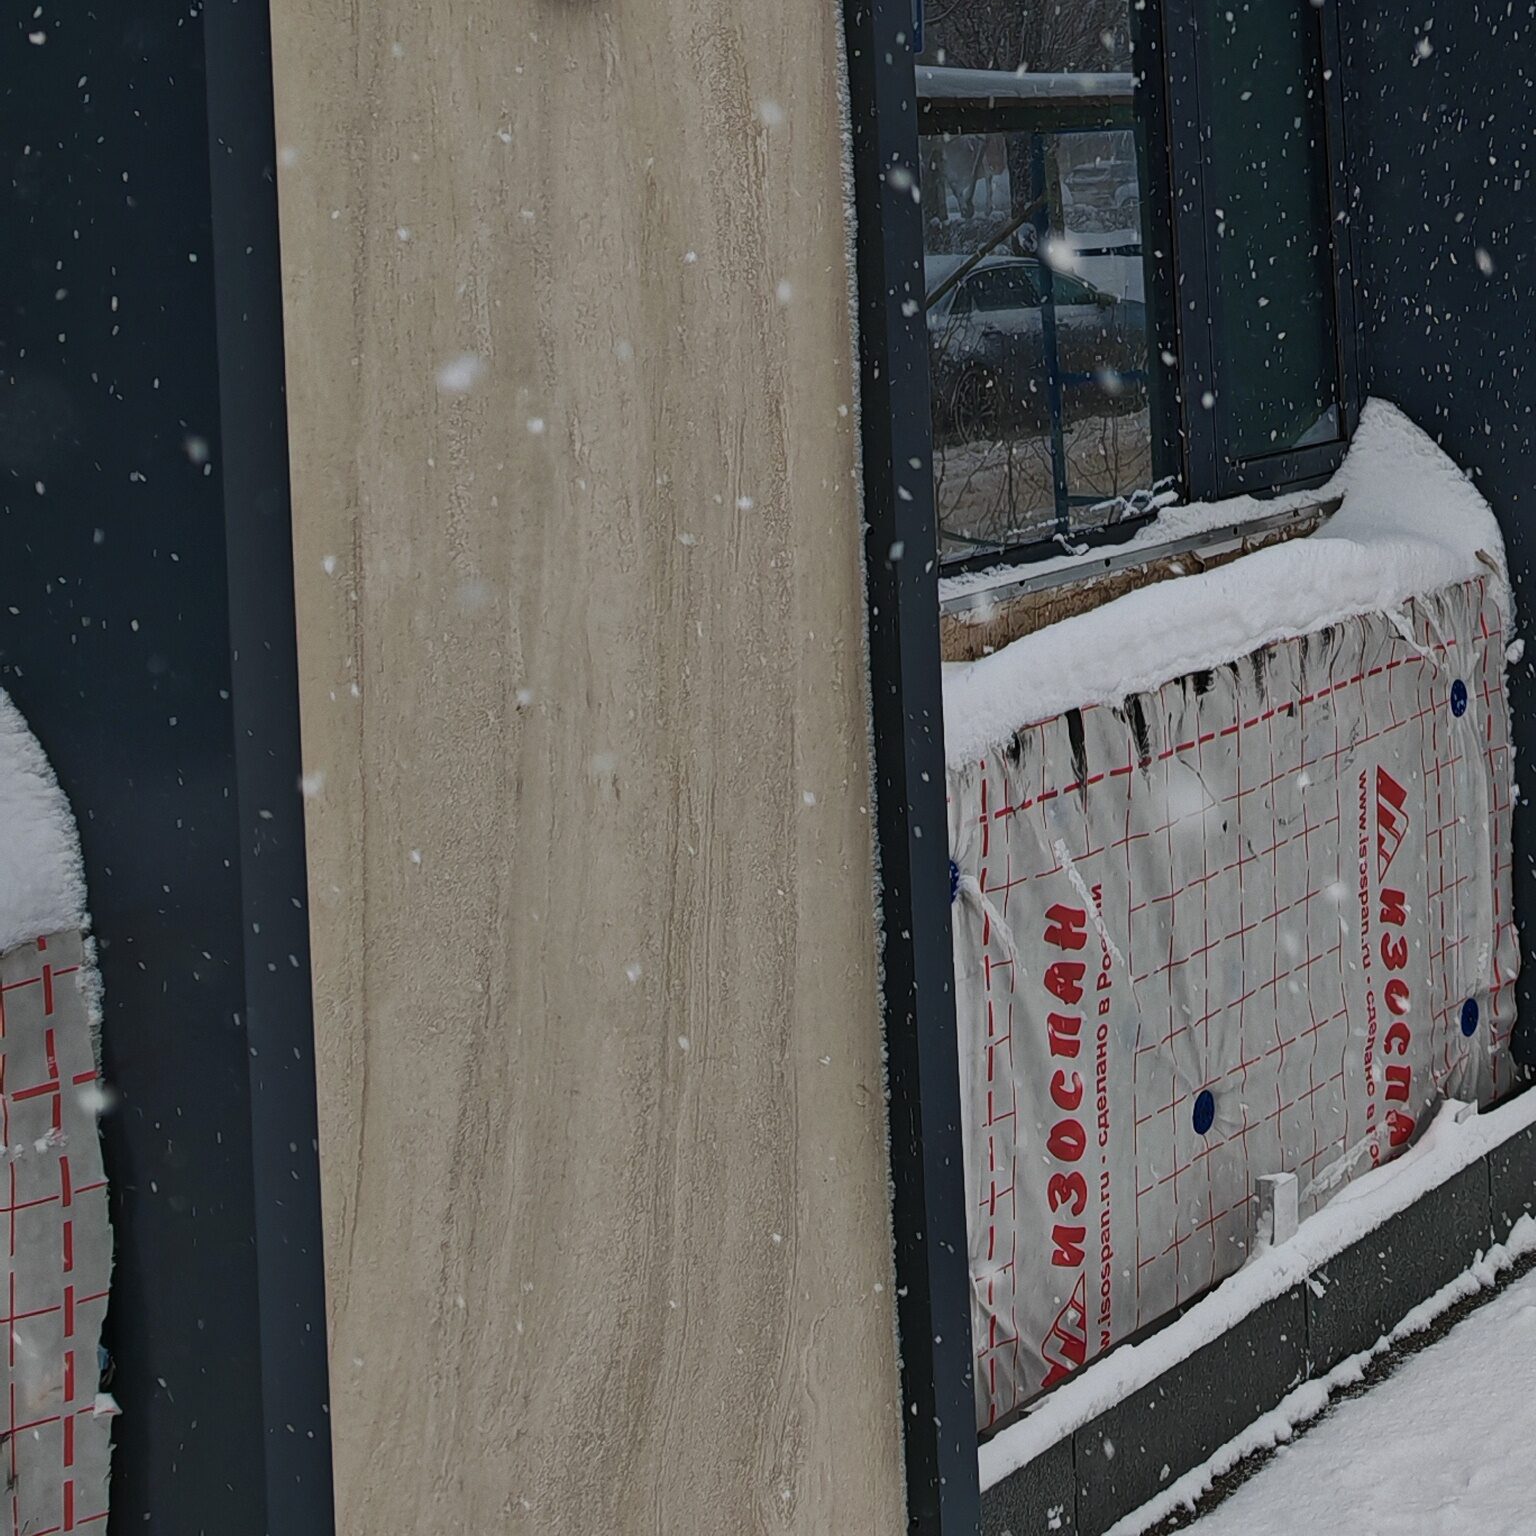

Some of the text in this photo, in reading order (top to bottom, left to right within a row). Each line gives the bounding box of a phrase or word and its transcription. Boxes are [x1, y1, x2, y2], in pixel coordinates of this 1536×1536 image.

[1359, 768, 1372, 970] www.isospan.ru
[1044, 903, 1088, 1268] ИЗОСПАН
[1096, 1023, 1110, 1147] сделано
[1363, 990, 1378, 1098] сделано
